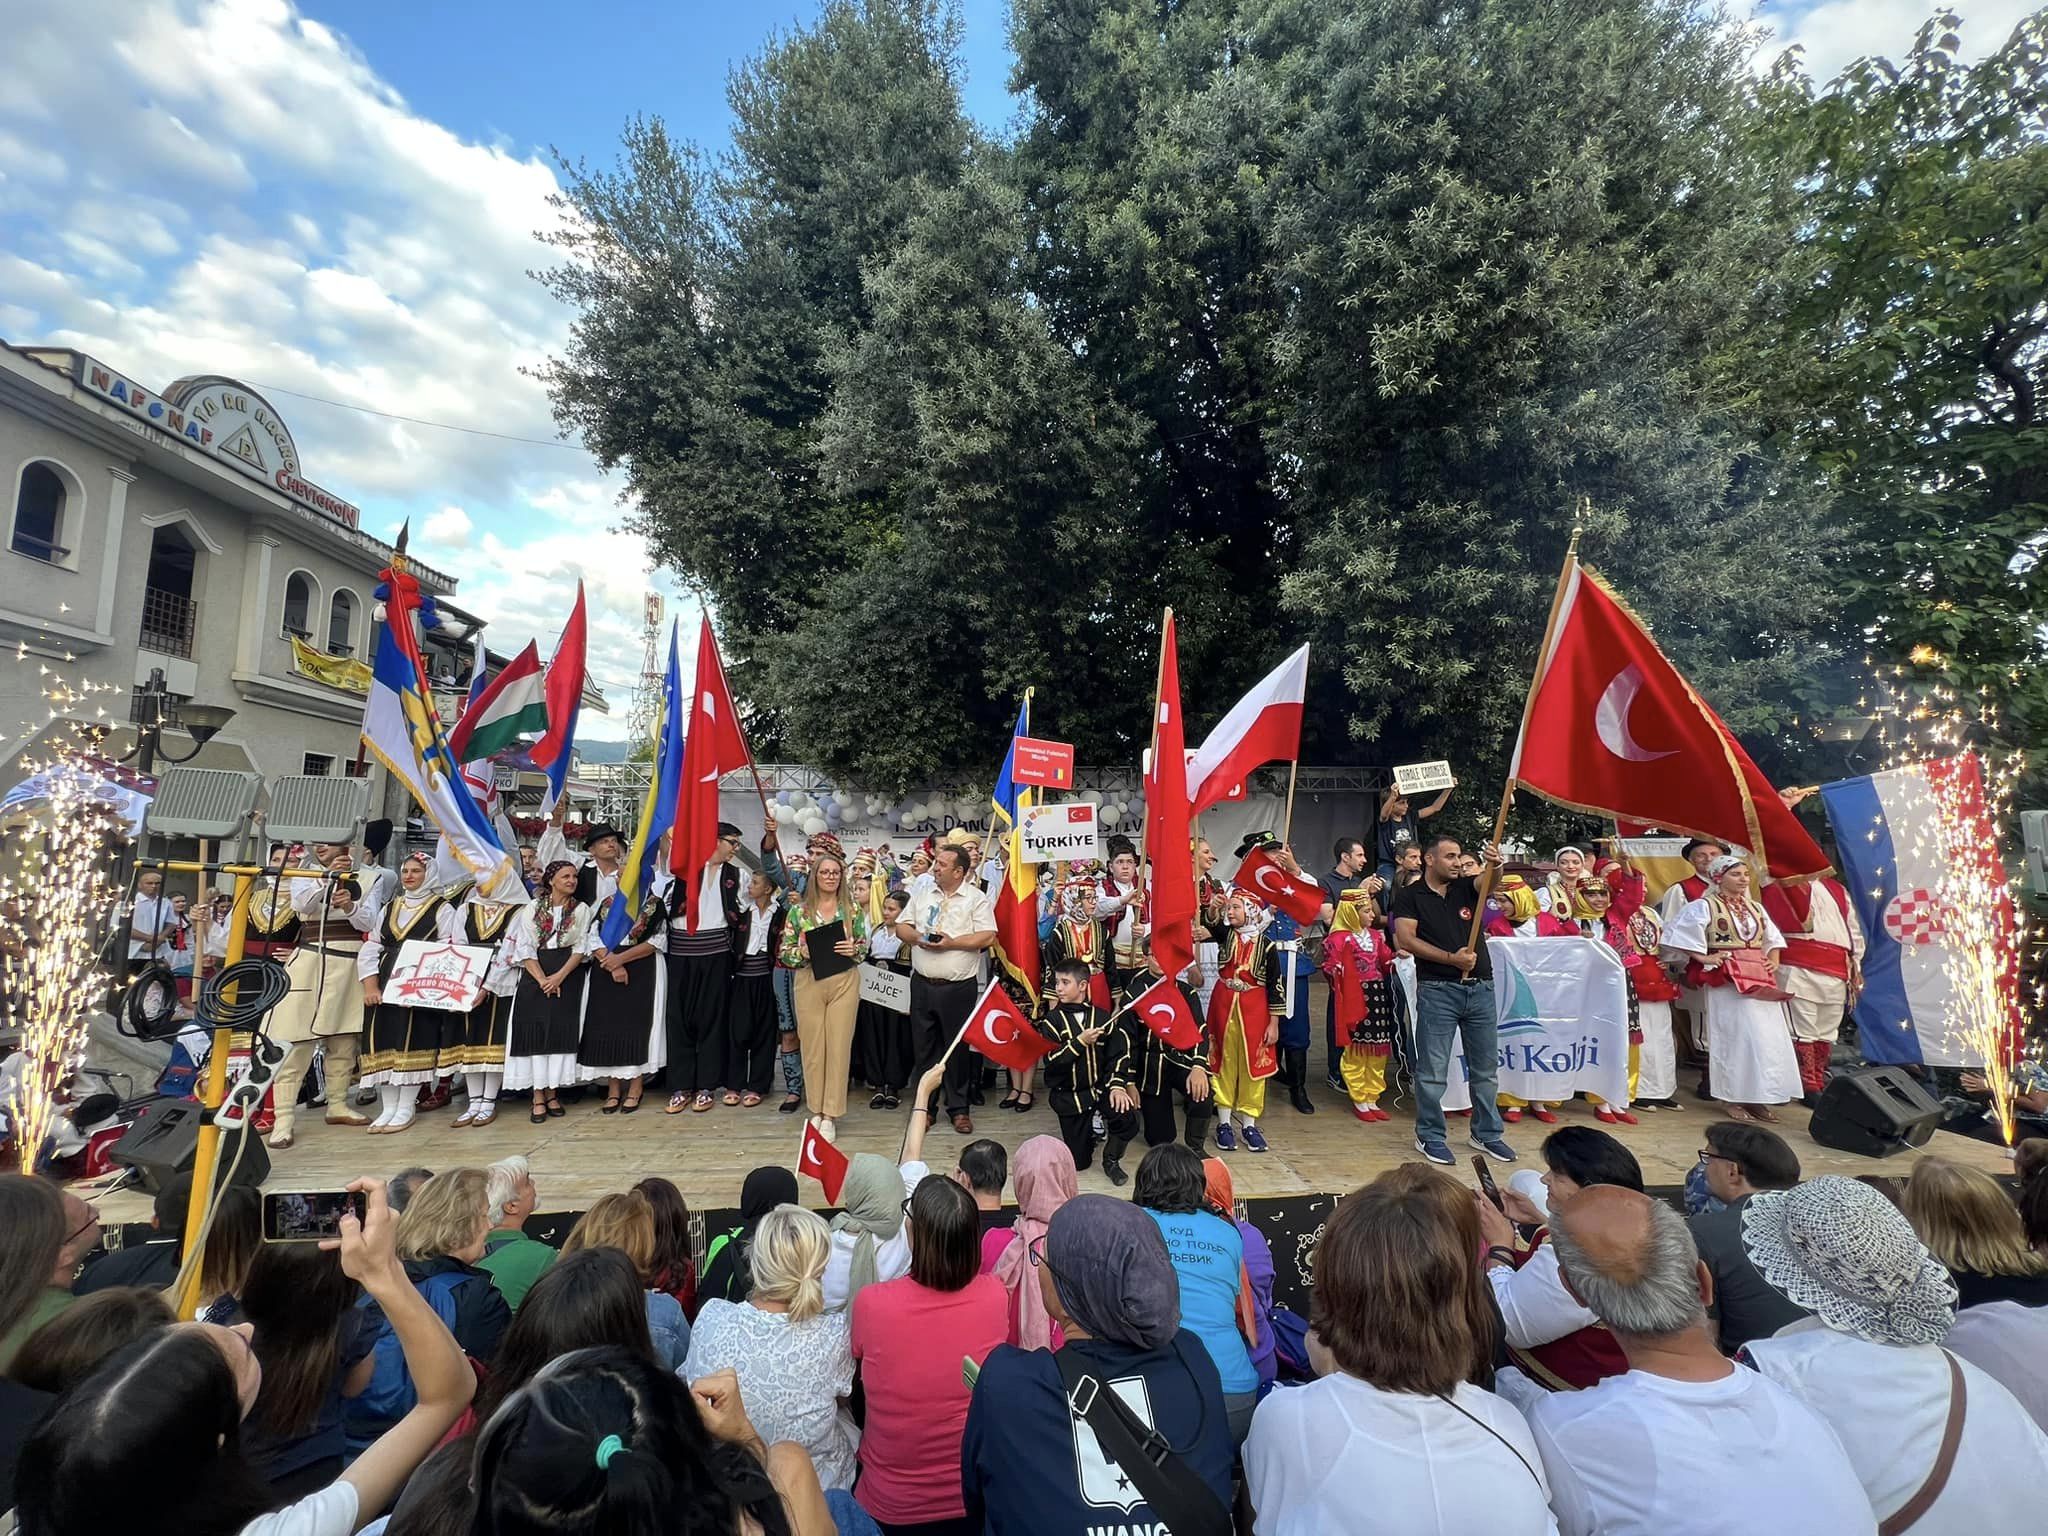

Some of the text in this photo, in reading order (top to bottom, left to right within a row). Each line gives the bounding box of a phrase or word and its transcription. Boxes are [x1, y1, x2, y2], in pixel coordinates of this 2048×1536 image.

[90, 366, 214, 446] NAF NAF
[840, 827, 869, 836] Travel
[1024, 833, 1094, 849] TÜRKİYE
[878, 971, 894, 982] KUD
[1170, 1226, 1194, 1237] КУД
[1165, 1239, 1180, 1248] НО
[1169, 1252, 1214, 1265] ЉЕВИК
